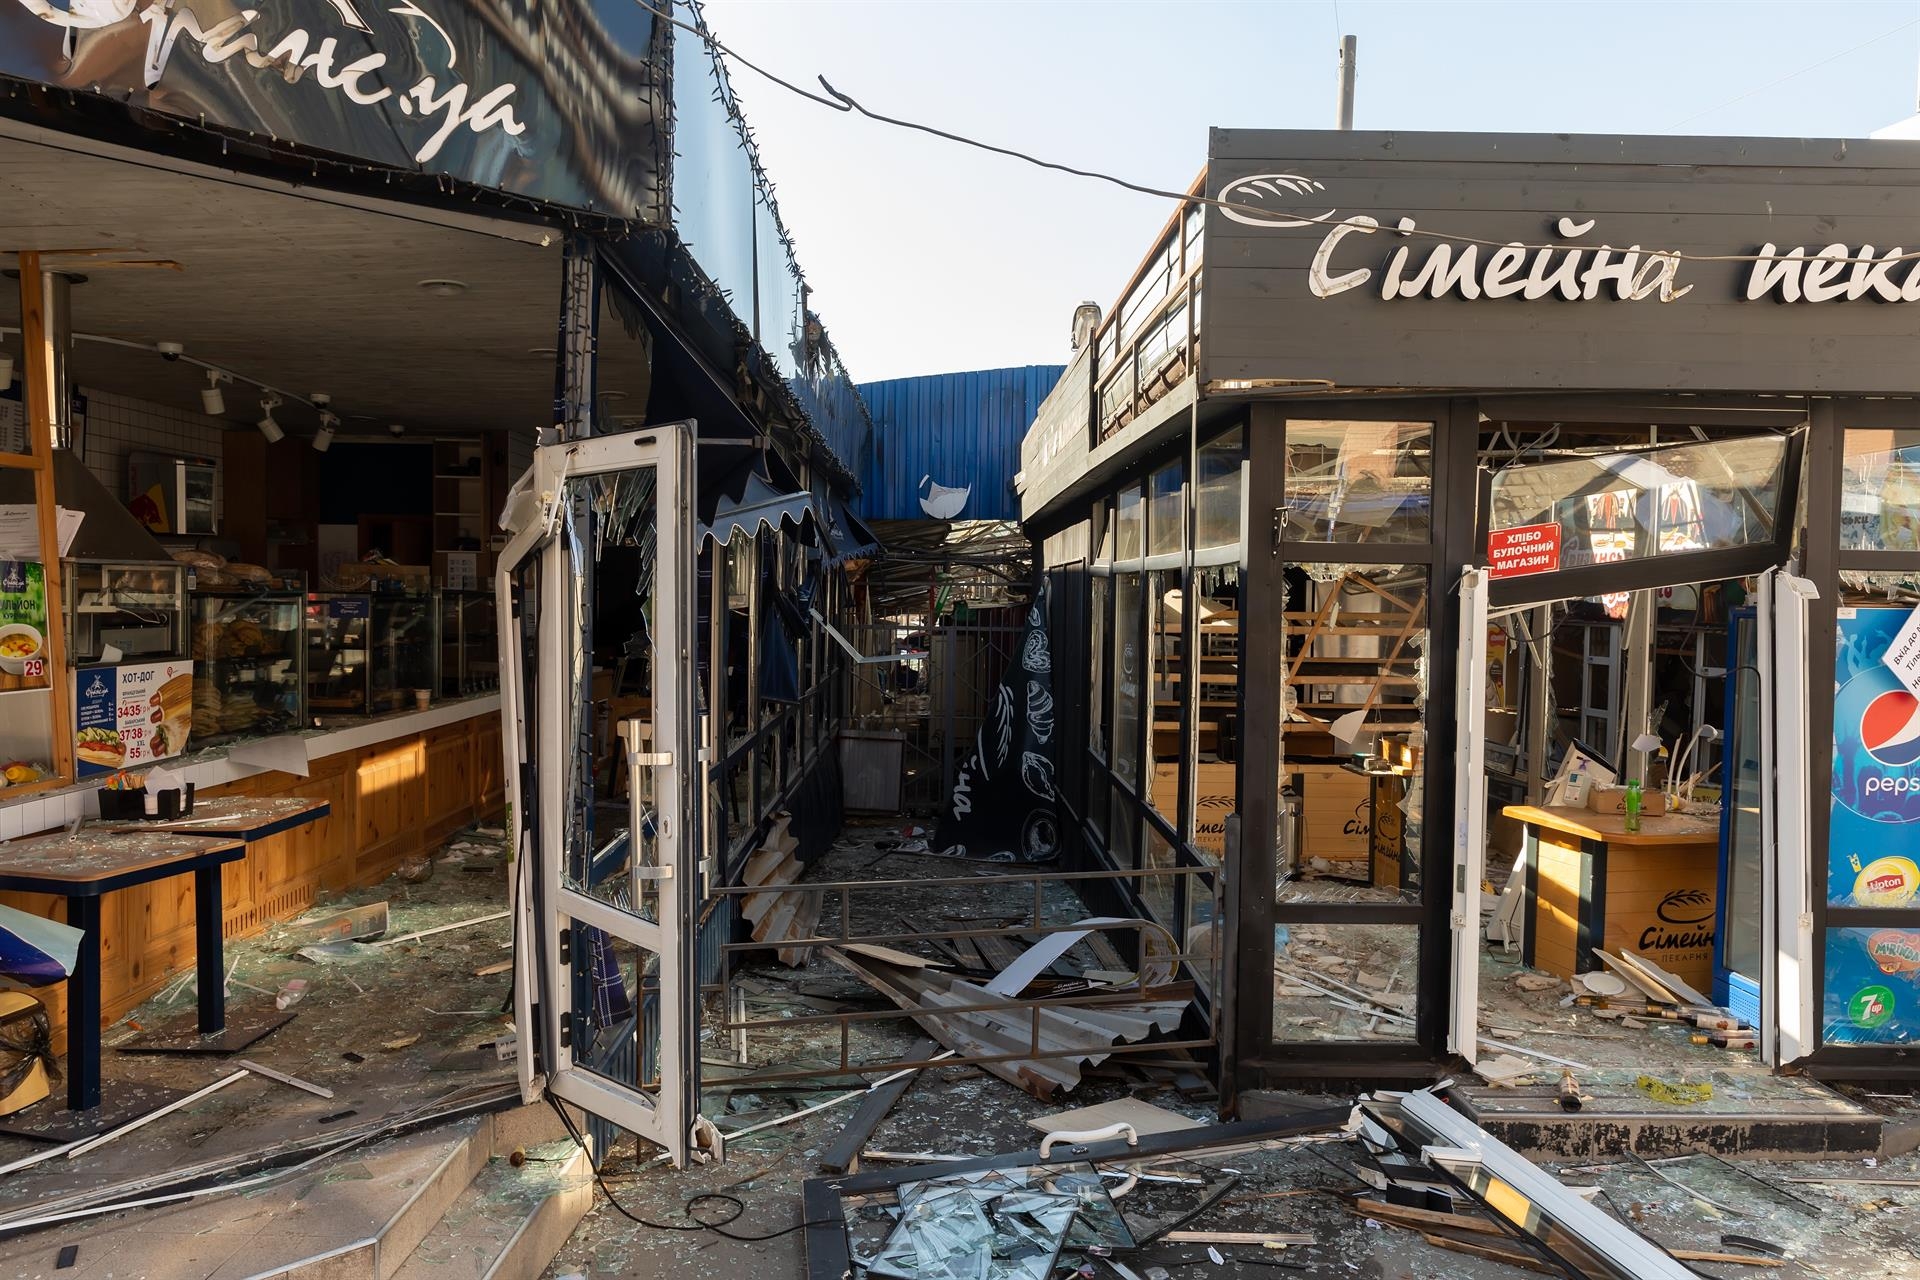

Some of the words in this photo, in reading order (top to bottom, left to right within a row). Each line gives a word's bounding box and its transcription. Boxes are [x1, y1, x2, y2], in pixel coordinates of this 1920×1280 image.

[1308, 214, 1694, 303] Сімейна
[1507, 531, 1542, 545] ХЛІБО
[1493, 540, 1555, 559] БУЛОЧНИЙ
[1496, 555, 1550, 571] МАГАЗИН
[1893, 645, 1911, 666] Вхід
[1908, 632, 1919, 647] до
[25, 661, 43, 676] 29
[122, 670, 155, 684] ХОТ-ДОГ
[130, 748, 141, 759] 55
[1661, 952, 1709, 963] ПЕКАРНЯ
